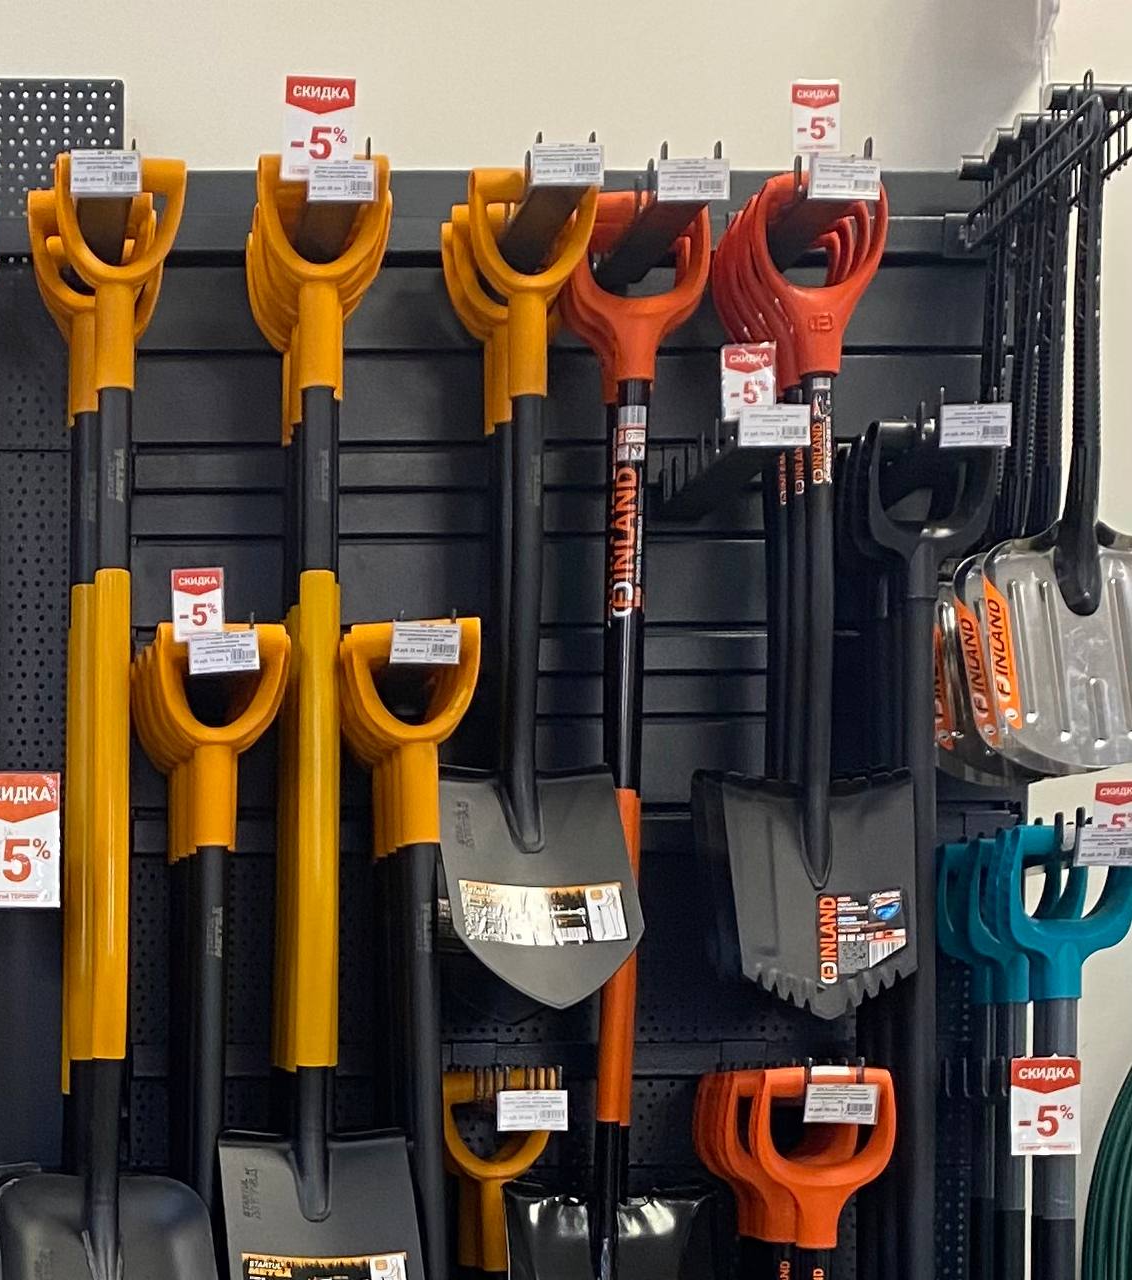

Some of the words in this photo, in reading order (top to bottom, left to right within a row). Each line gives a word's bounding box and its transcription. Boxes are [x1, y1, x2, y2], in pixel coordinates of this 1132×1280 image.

[293, 84, 351, 102] СКИДКА
[796, 87, 836, 100] СКИДКА
[797, 116, 836, 140] -5%
[290, 126, 348, 162] -5%
[729, 351, 769, 368] СКИДКА
[812, 420, 824, 485] FINLAND
[611, 466, 637, 617] FINLAND
[178, 574, 218, 588] СКИДКА
[179, 603, 217, 626] -5%
[986, 599, 1012, 703] FINLAND
[962, 618, 989, 719] FINLAND
[1098, 785, 1132, 799] СКИДК
[820, 896, 838, 984] FINLAND
[1019, 1065, 1075, 1085] СКИДКА
[1019, 1104, 1074, 1139] -5%
